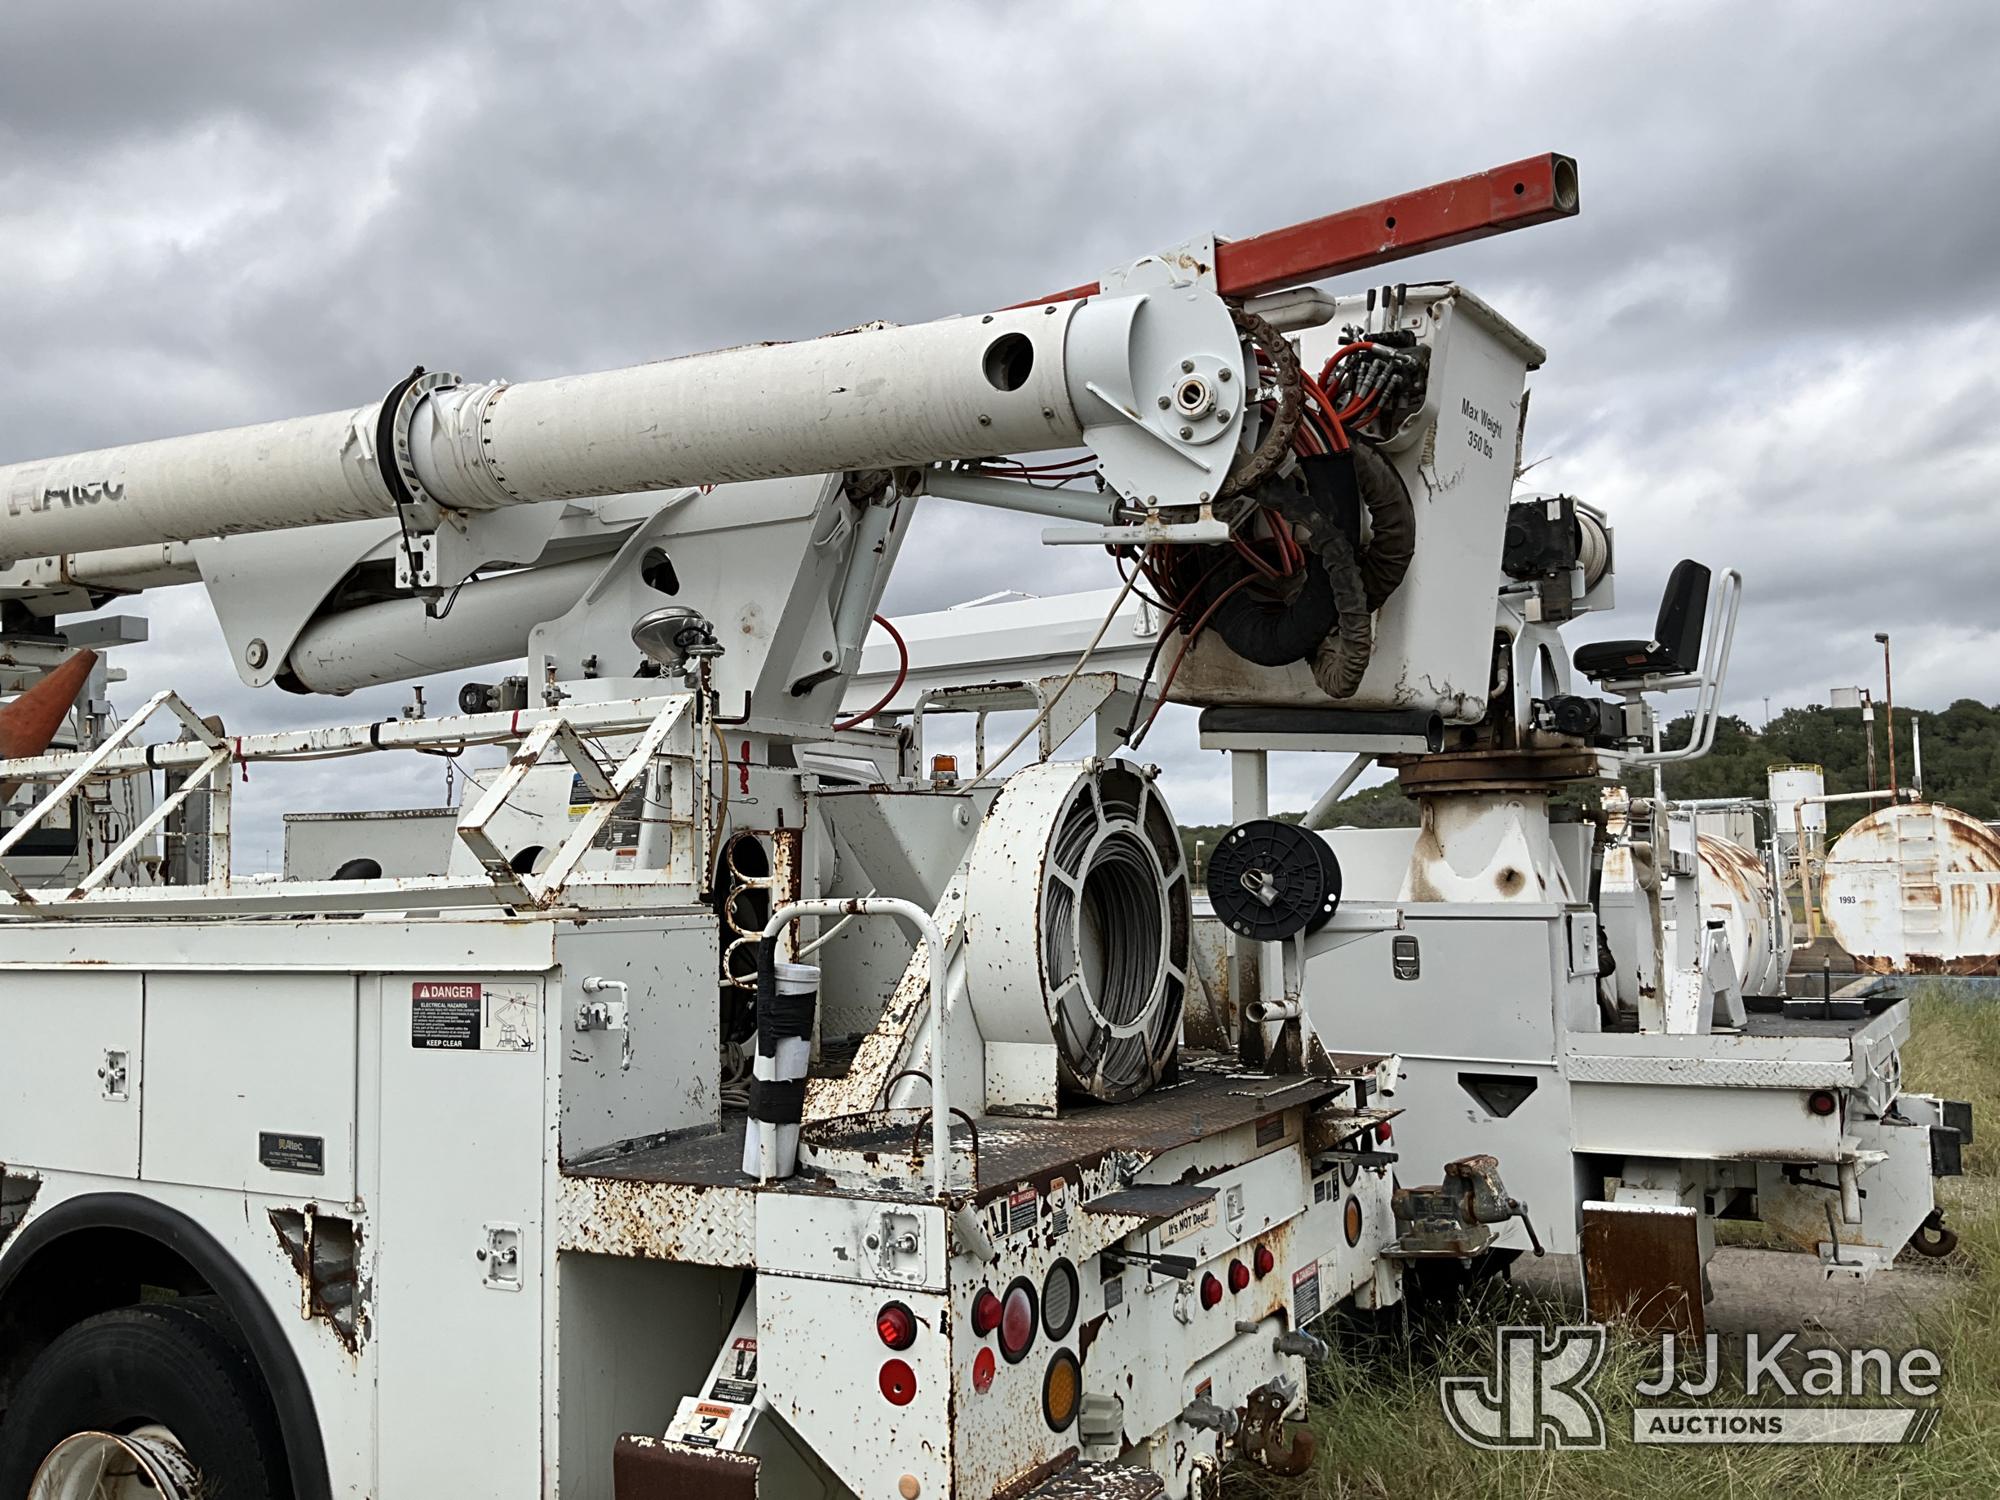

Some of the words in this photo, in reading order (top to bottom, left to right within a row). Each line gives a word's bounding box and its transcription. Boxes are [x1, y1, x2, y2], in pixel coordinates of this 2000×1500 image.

[1461, 397, 1478, 423] Max
[1480, 408, 1502, 440] Weight
[1467, 430, 1483, 452] 350
[1483, 438, 1493, 460] lbs
[1838, 896, 1856, 904] 1993
[431, 986, 473, 998] DANGER
[426, 1039, 442, 1047] KEEP
[442, 1039, 463, 1047] CLEAR
[1168, 1222, 1178, 1236] It's
[1179, 1215, 1192, 1231] NOT
[1193, 1208, 1209, 1225] Dead!
[704, 1406, 730, 1416] WARNING
